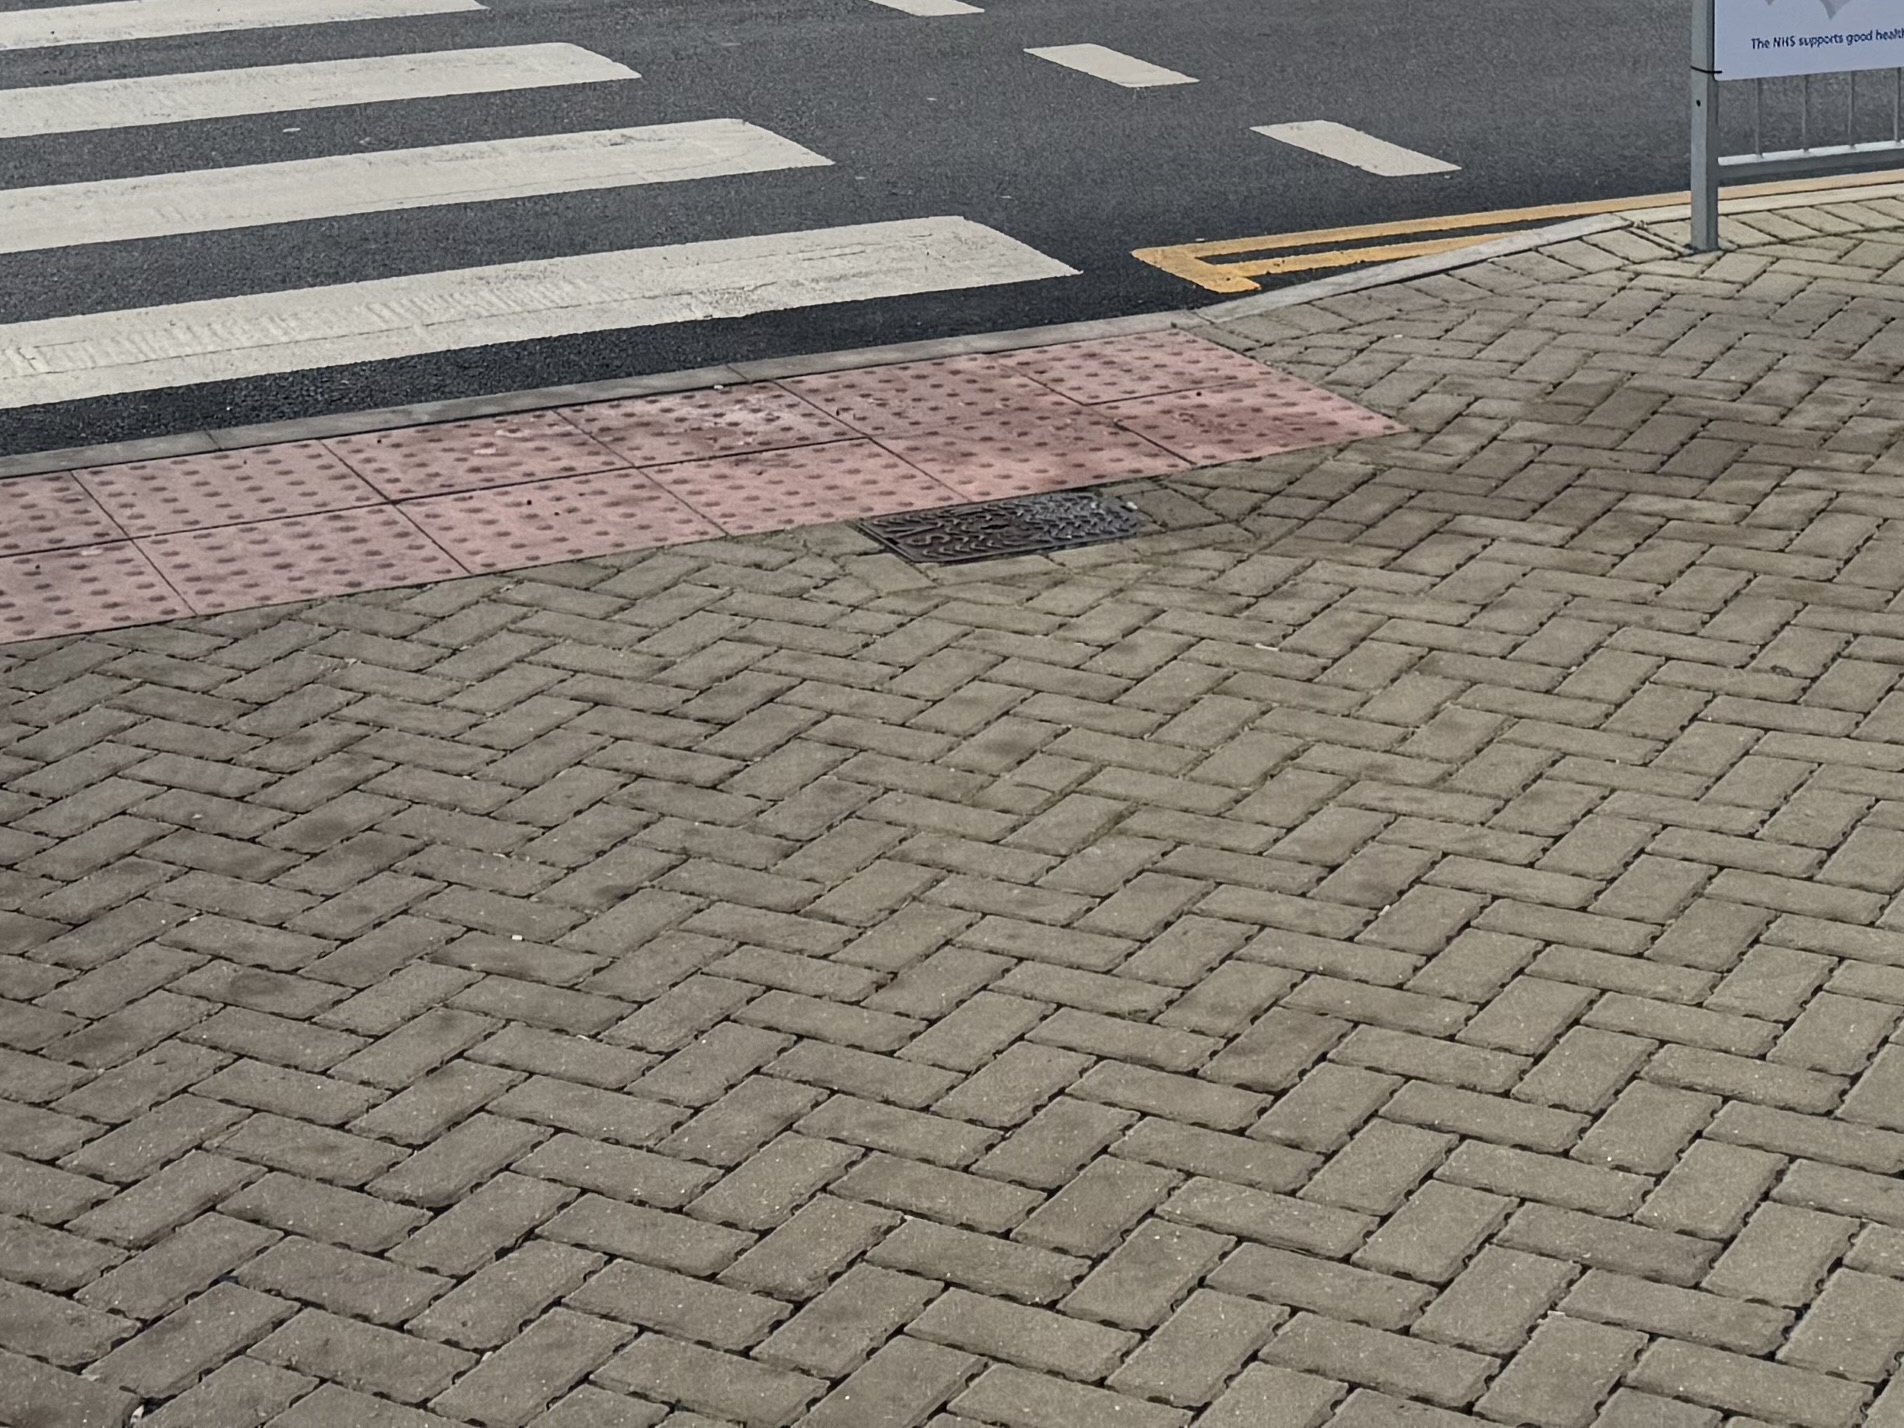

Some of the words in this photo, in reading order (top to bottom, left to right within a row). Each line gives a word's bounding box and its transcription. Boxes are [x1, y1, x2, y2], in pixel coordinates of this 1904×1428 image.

[1752, 37, 1770, 50] The
[1773, 36, 1796, 48] NHS
[1799, 34, 1844, 48] supports
[1846, 30, 1873, 46] good
